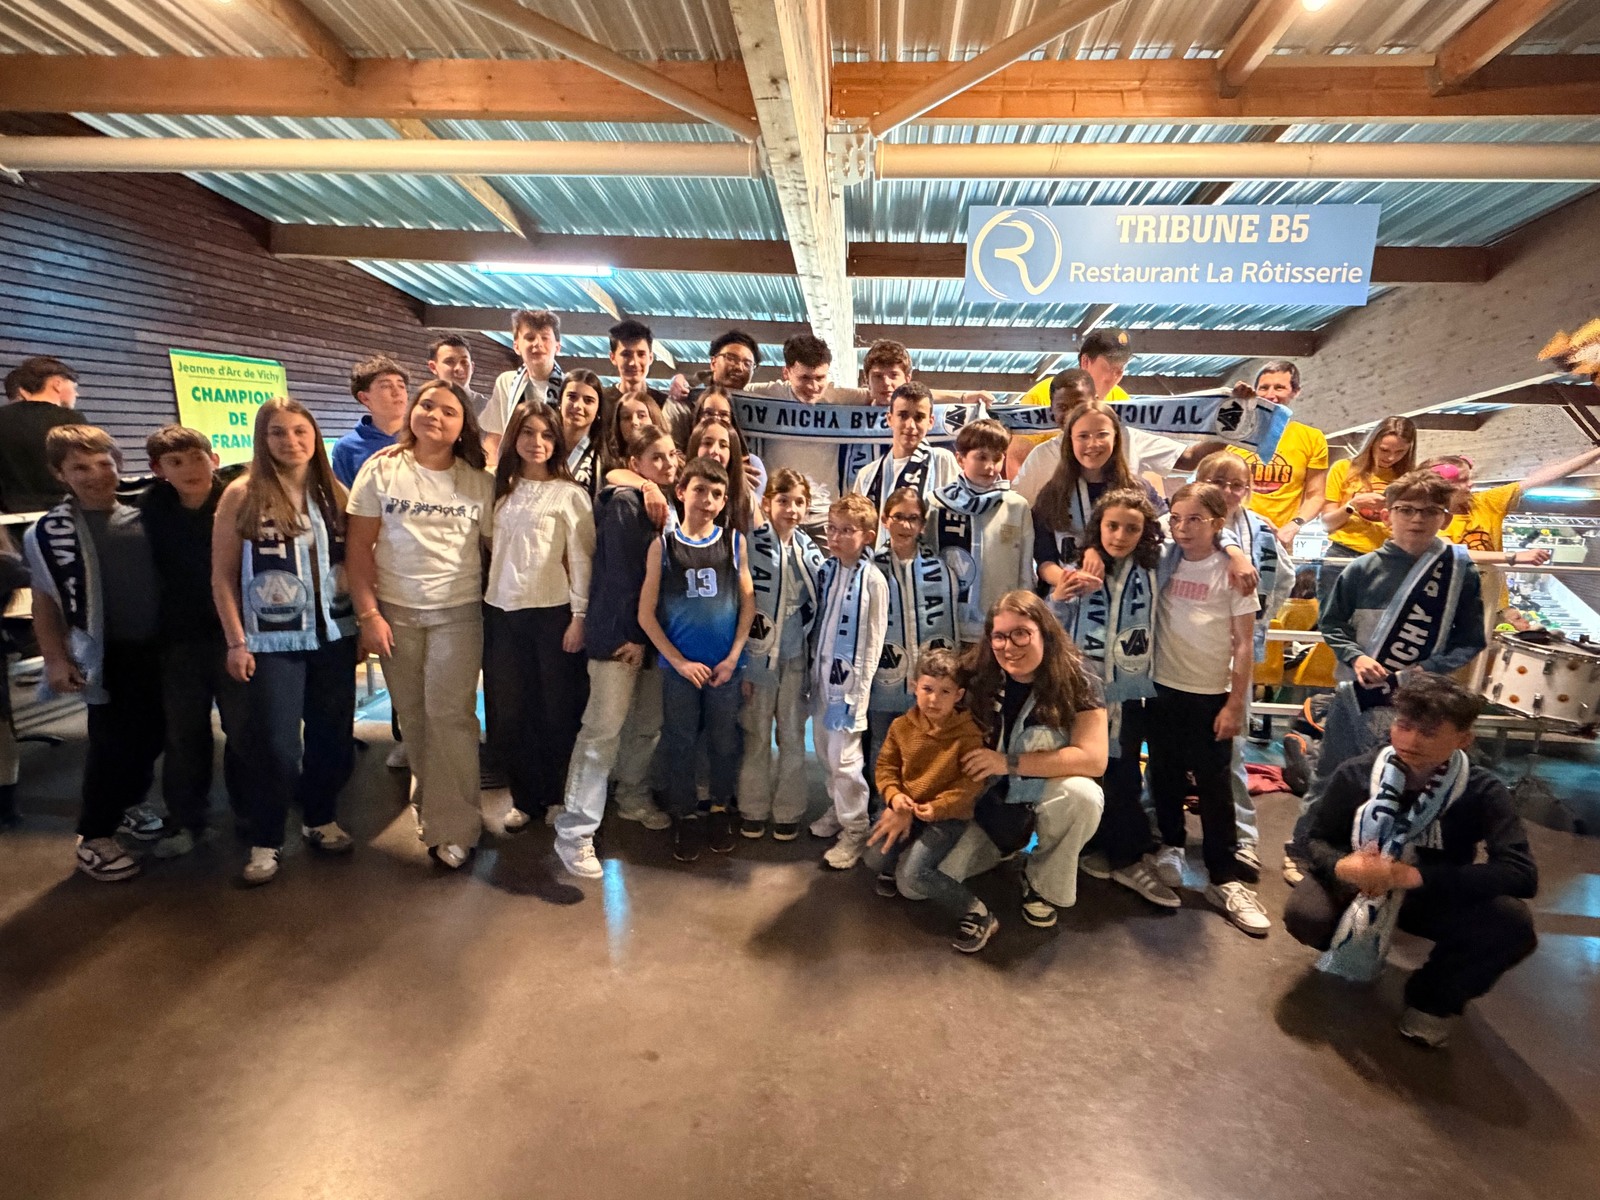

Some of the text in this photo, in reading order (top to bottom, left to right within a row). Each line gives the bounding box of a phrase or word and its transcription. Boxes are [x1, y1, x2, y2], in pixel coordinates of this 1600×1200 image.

[1116, 213, 1311, 244] TRIBUNE B5
[1069, 259, 1363, 284] Restaurant La Rôtisserie
[178, 361, 280, 383] Jeanne d'Arc de Vichy
[228, 411, 248, 426] DE
[211, 434, 252, 448] FRAN
[685, 567, 718, 598] 13
